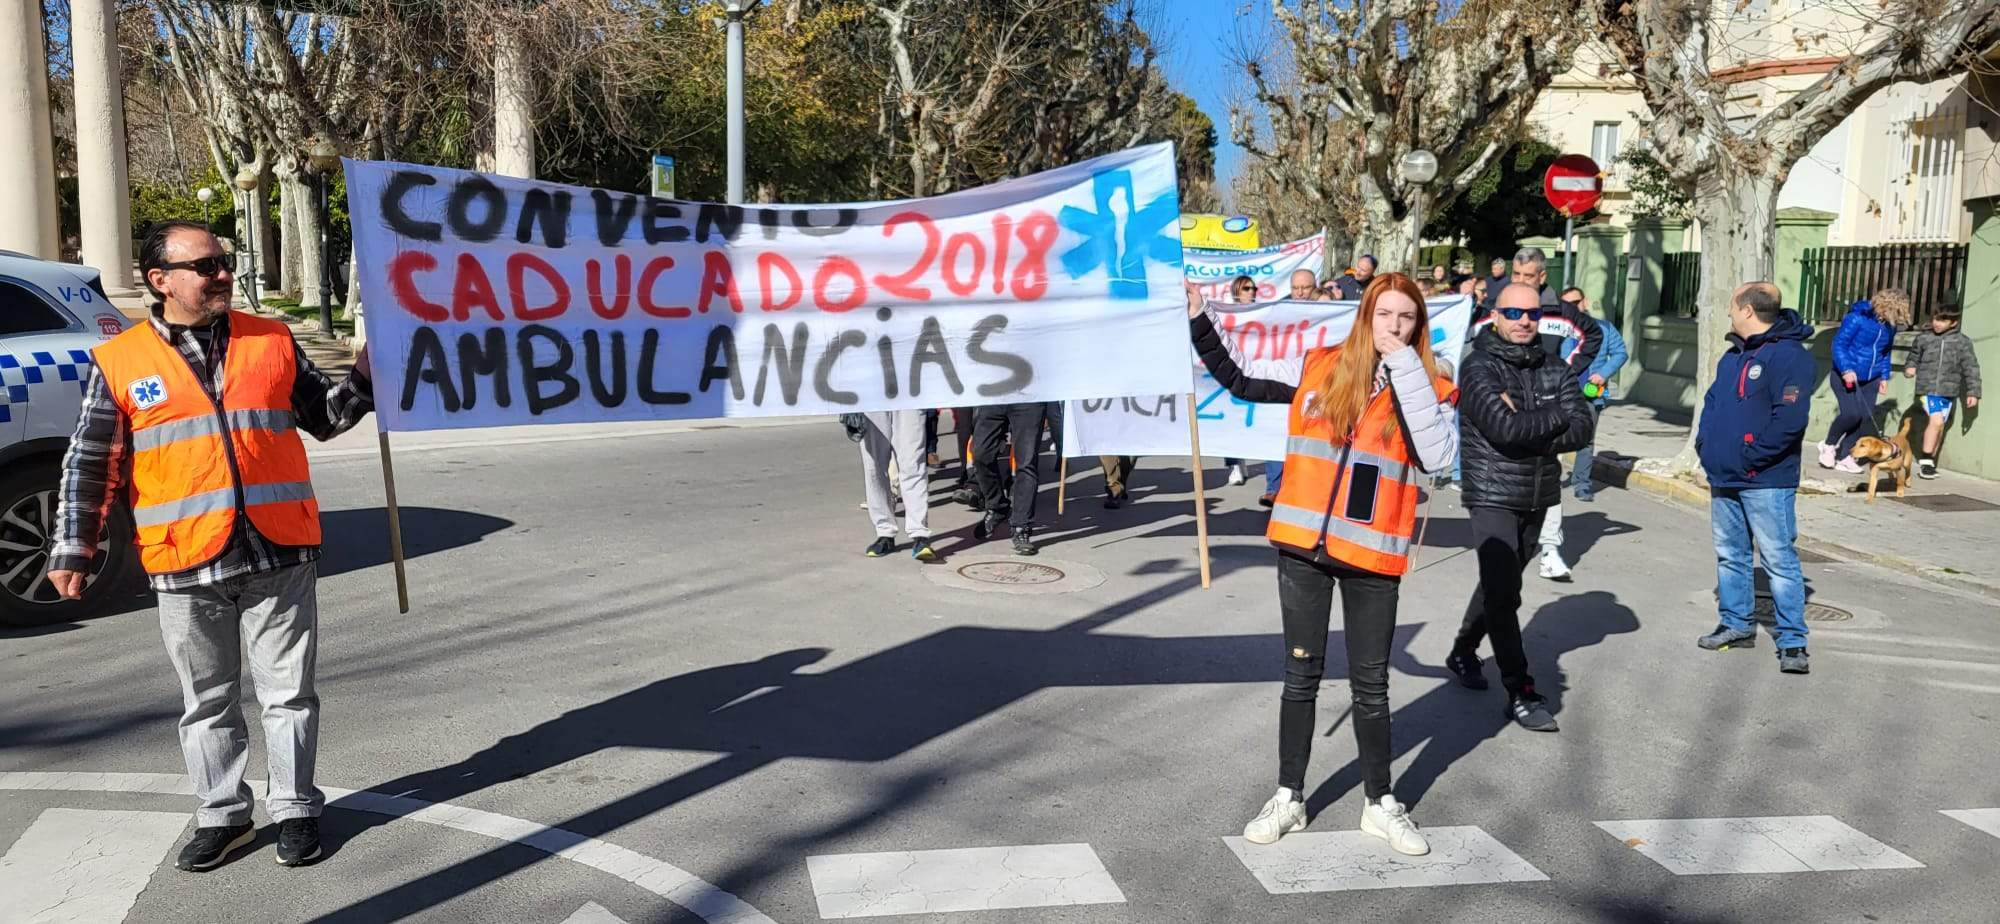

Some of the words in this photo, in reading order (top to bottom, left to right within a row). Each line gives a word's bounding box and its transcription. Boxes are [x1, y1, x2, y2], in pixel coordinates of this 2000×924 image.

[387, 250, 869, 322] CADUCADO
[873, 209, 1060, 301] 2018
[1185, 264, 1274, 277] ACUERDO
[103, 324, 119, 334] 112
